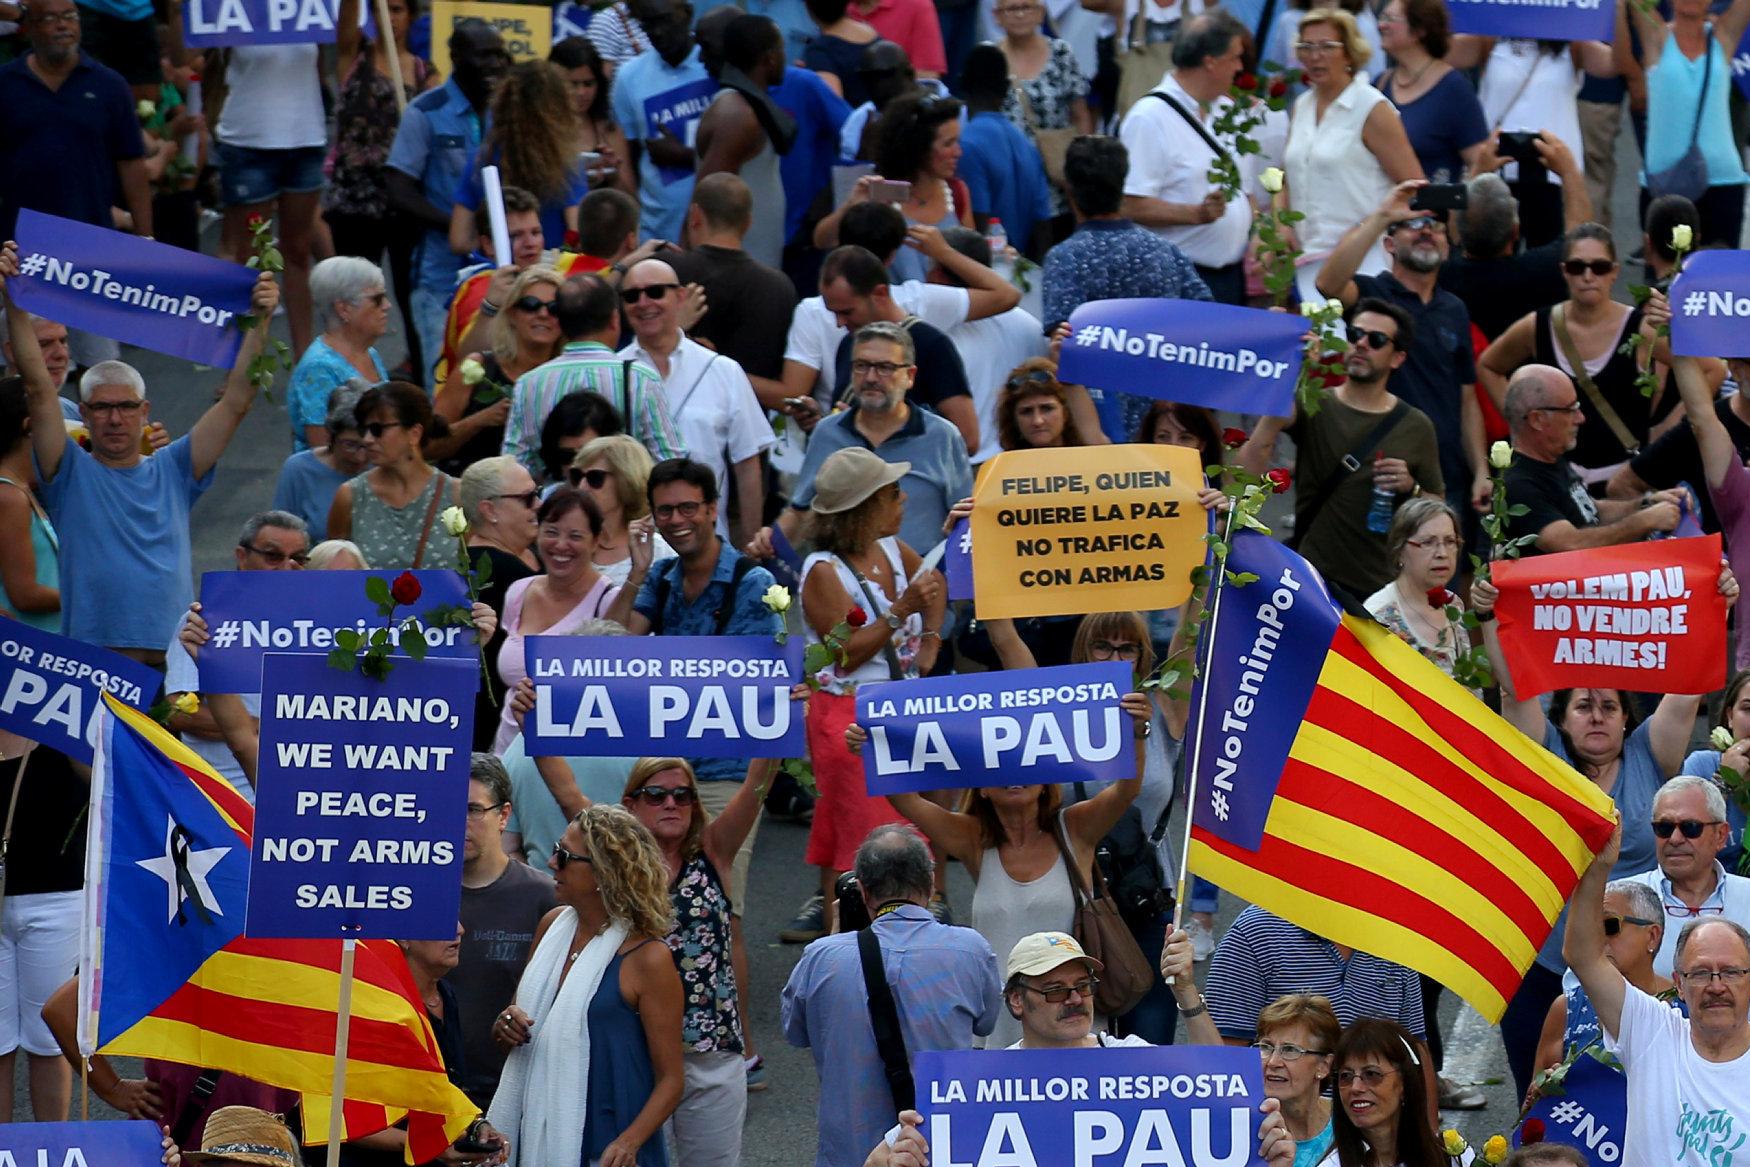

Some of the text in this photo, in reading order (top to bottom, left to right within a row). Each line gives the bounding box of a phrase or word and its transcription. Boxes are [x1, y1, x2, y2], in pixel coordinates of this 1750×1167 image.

[21, 253, 232, 326] #NoTenimPor
[1076, 325, 1289, 378] #NoTenimPor
[1002, 471, 1170, 495] FELIPE, QUIEN
[997, 502, 1180, 526] QUIERE LA PAZ
[1017, 533, 1164, 556] NO TRAFICA
[1020, 564, 1164, 588] CON ARMAS
[1531, 566, 1691, 601] VOLEM PAU,
[1534, 605, 1687, 635] NO VENDRE
[536, 659, 789, 677] LA MILLOR RESPOSTA
[1554, 638, 1666, 669] ARMES!
[1211, 566, 1299, 822] #NoTenimPor
[276, 695, 458, 729] MARIANO,
[536, 685, 790, 741] LA PAU
[277, 743, 453, 770] WE WANT
[297, 792, 425, 823] PEACE,
[263, 839, 453, 864] NOT ARMS
[296, 885, 412, 909] SALES
[932, 1075, 1248, 1103] LA MILLOR RESPOSTA
